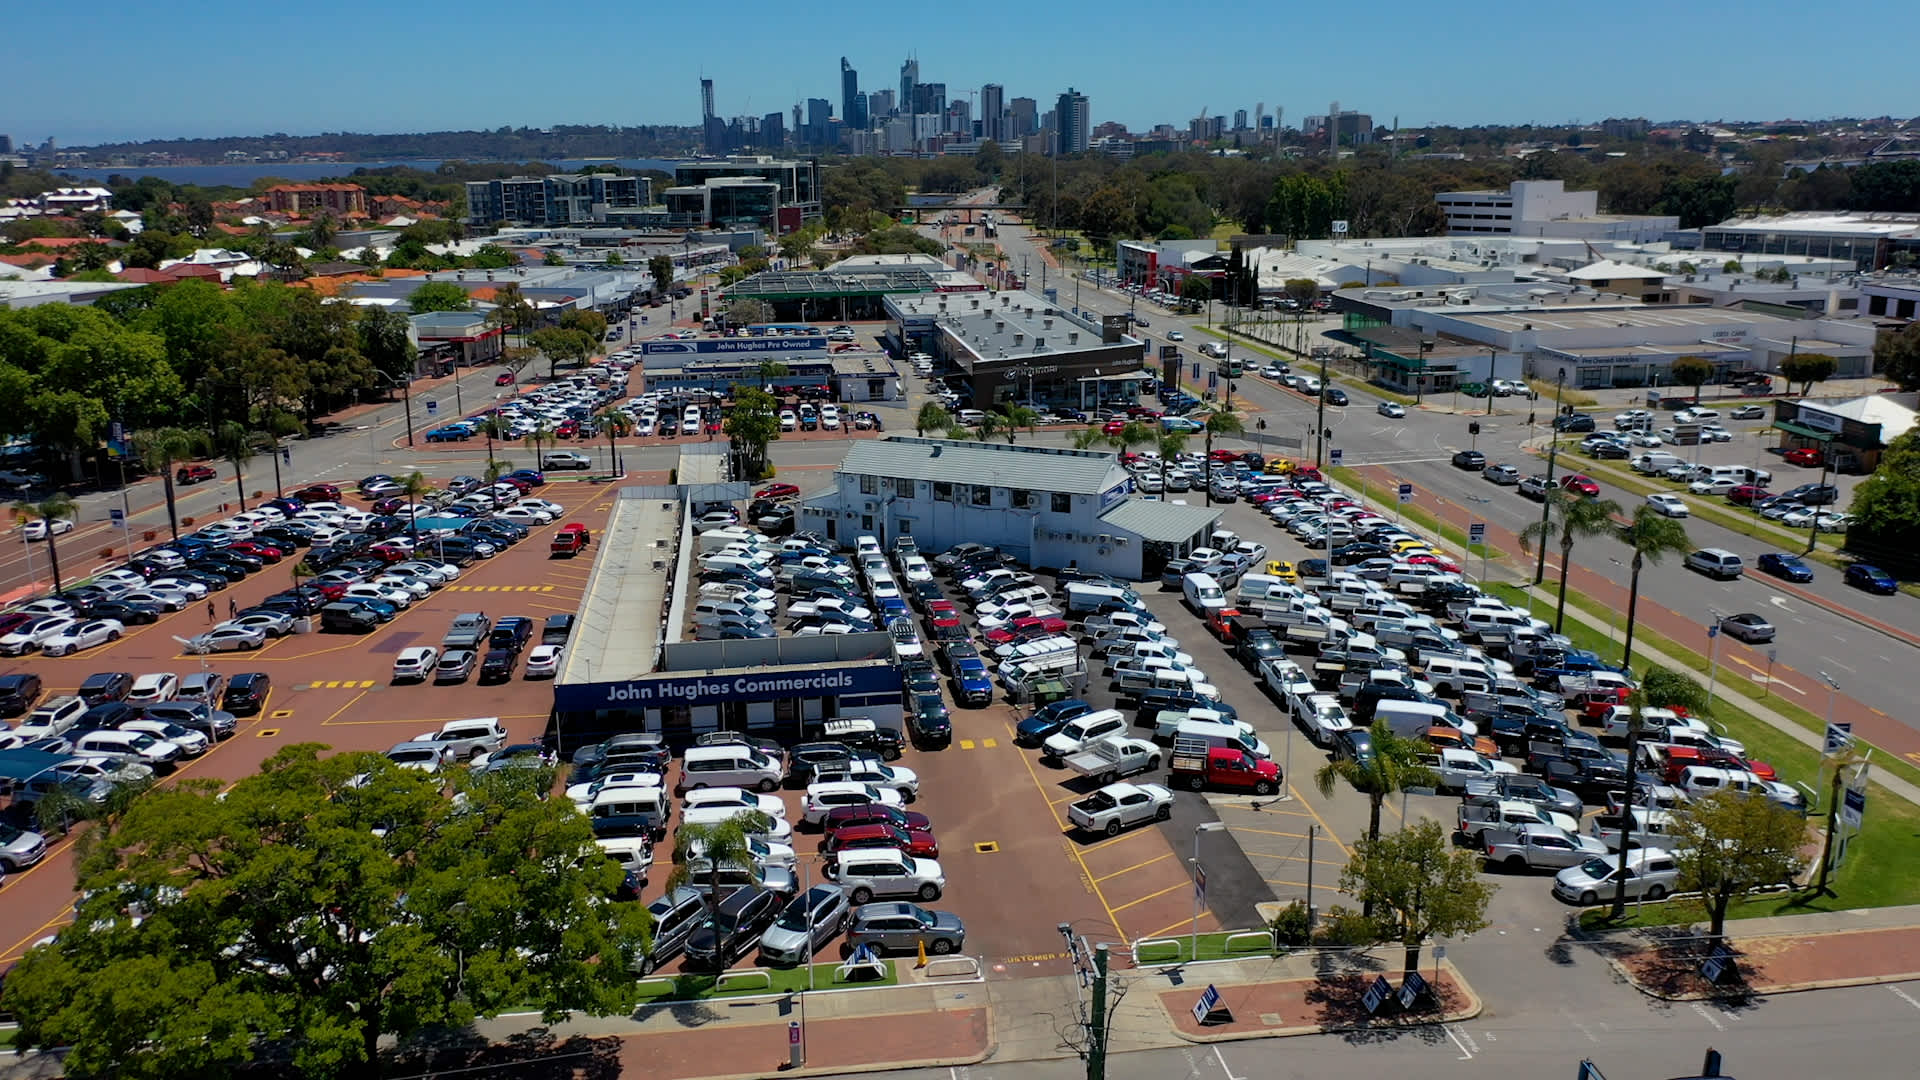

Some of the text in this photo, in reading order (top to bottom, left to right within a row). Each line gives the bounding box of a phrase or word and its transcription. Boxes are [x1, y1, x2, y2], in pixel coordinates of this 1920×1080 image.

[716, 342, 735, 351] John
[736, 341, 766, 351] Hughes
[782, 340, 811, 348] Owned
[607, 671, 853, 701] John Hughes Commercials
